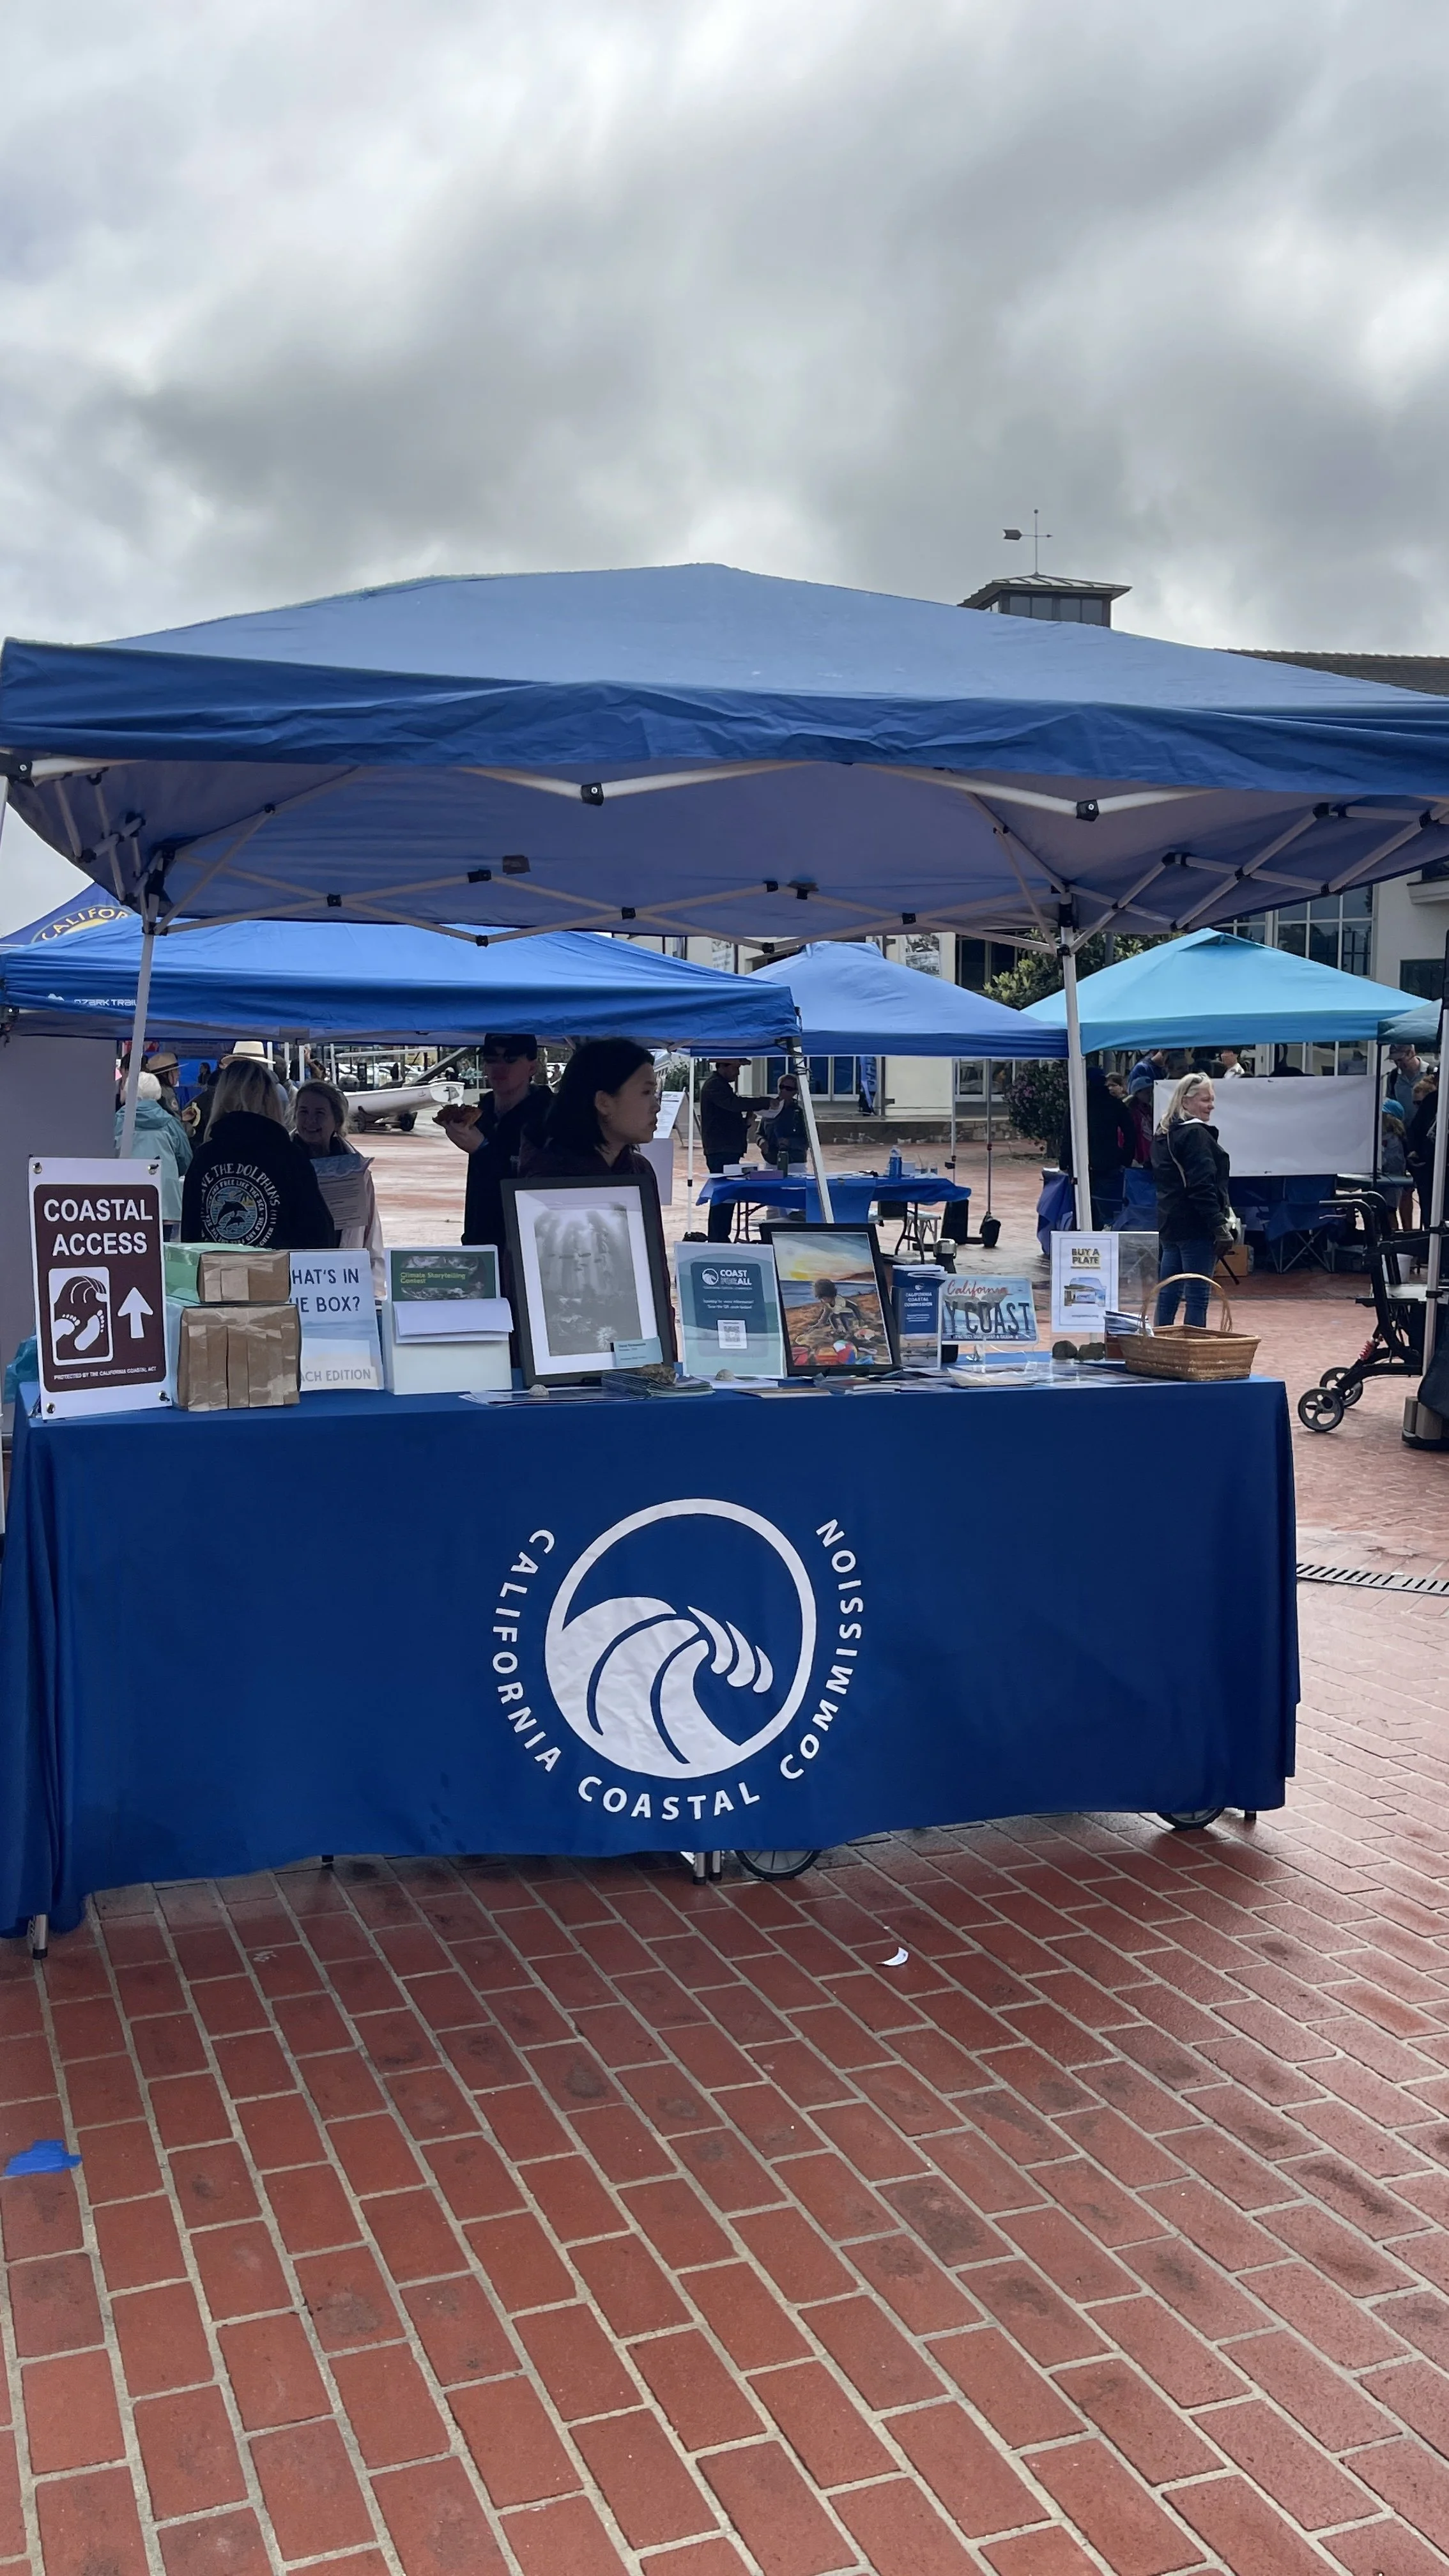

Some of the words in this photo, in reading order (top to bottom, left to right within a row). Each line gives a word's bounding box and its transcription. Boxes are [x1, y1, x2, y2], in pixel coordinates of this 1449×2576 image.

[211, 1163, 234, 1177] THE
[235, 1163, 280, 1206] DOLPHINS
[43, 1199, 153, 1222] COASTAL
[52, 1232, 148, 1256] ACCESS
[1072, 1256, 1100, 1264] PLATE
[291, 1269, 337, 1285] HAT'S
[344, 1268, 360, 1284] IN
[947, 1279, 1009, 1297] California
[316, 1296, 360, 1312] BOX?
[964, 1301, 1030, 1334] COAST
[326, 1368, 371, 1382] EDITION
[493, 1529, 561, 1772] CALIFORNIA
[578, 1776, 760, 1820] COASTAL
[779, 1519, 864, 1779] COMMISSION
